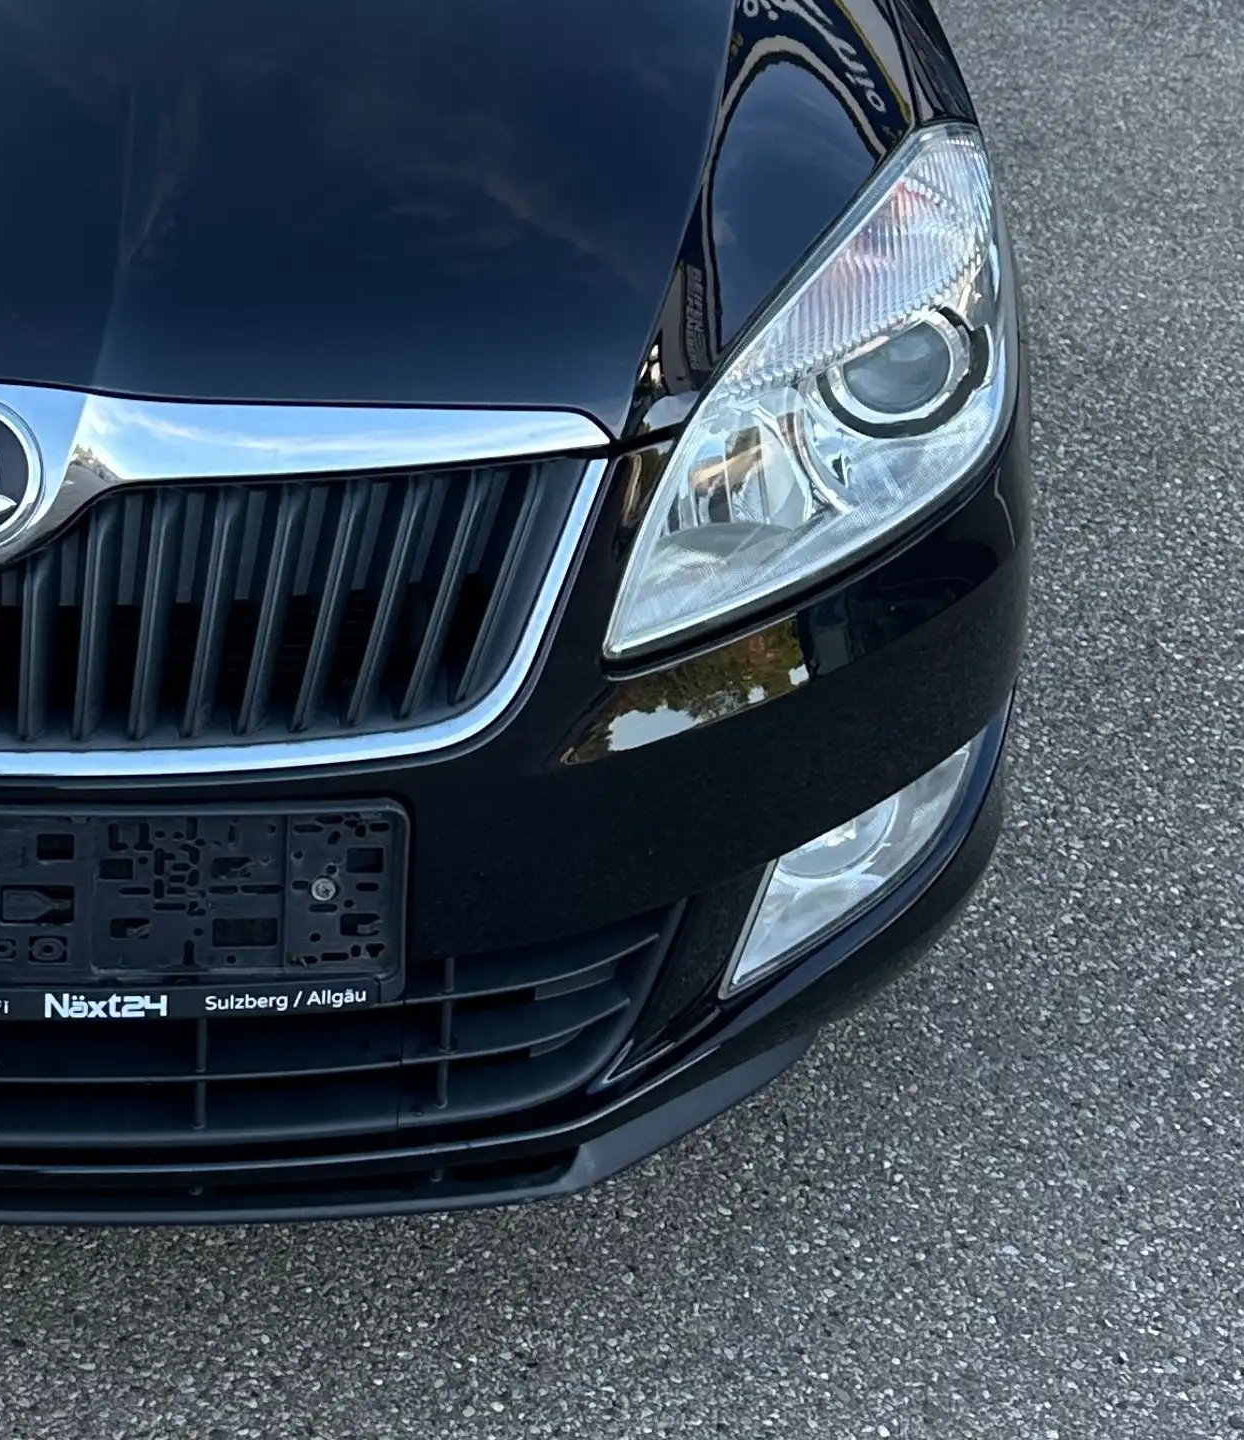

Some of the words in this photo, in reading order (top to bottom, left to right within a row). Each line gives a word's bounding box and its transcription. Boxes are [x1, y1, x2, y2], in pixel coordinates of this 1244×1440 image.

[44, 993, 168, 1019] Näxt24
[204, 994, 289, 1013] Sulzberg
[293, 990, 303, 1009] /
[307, 987, 367, 1008] Allgäu
